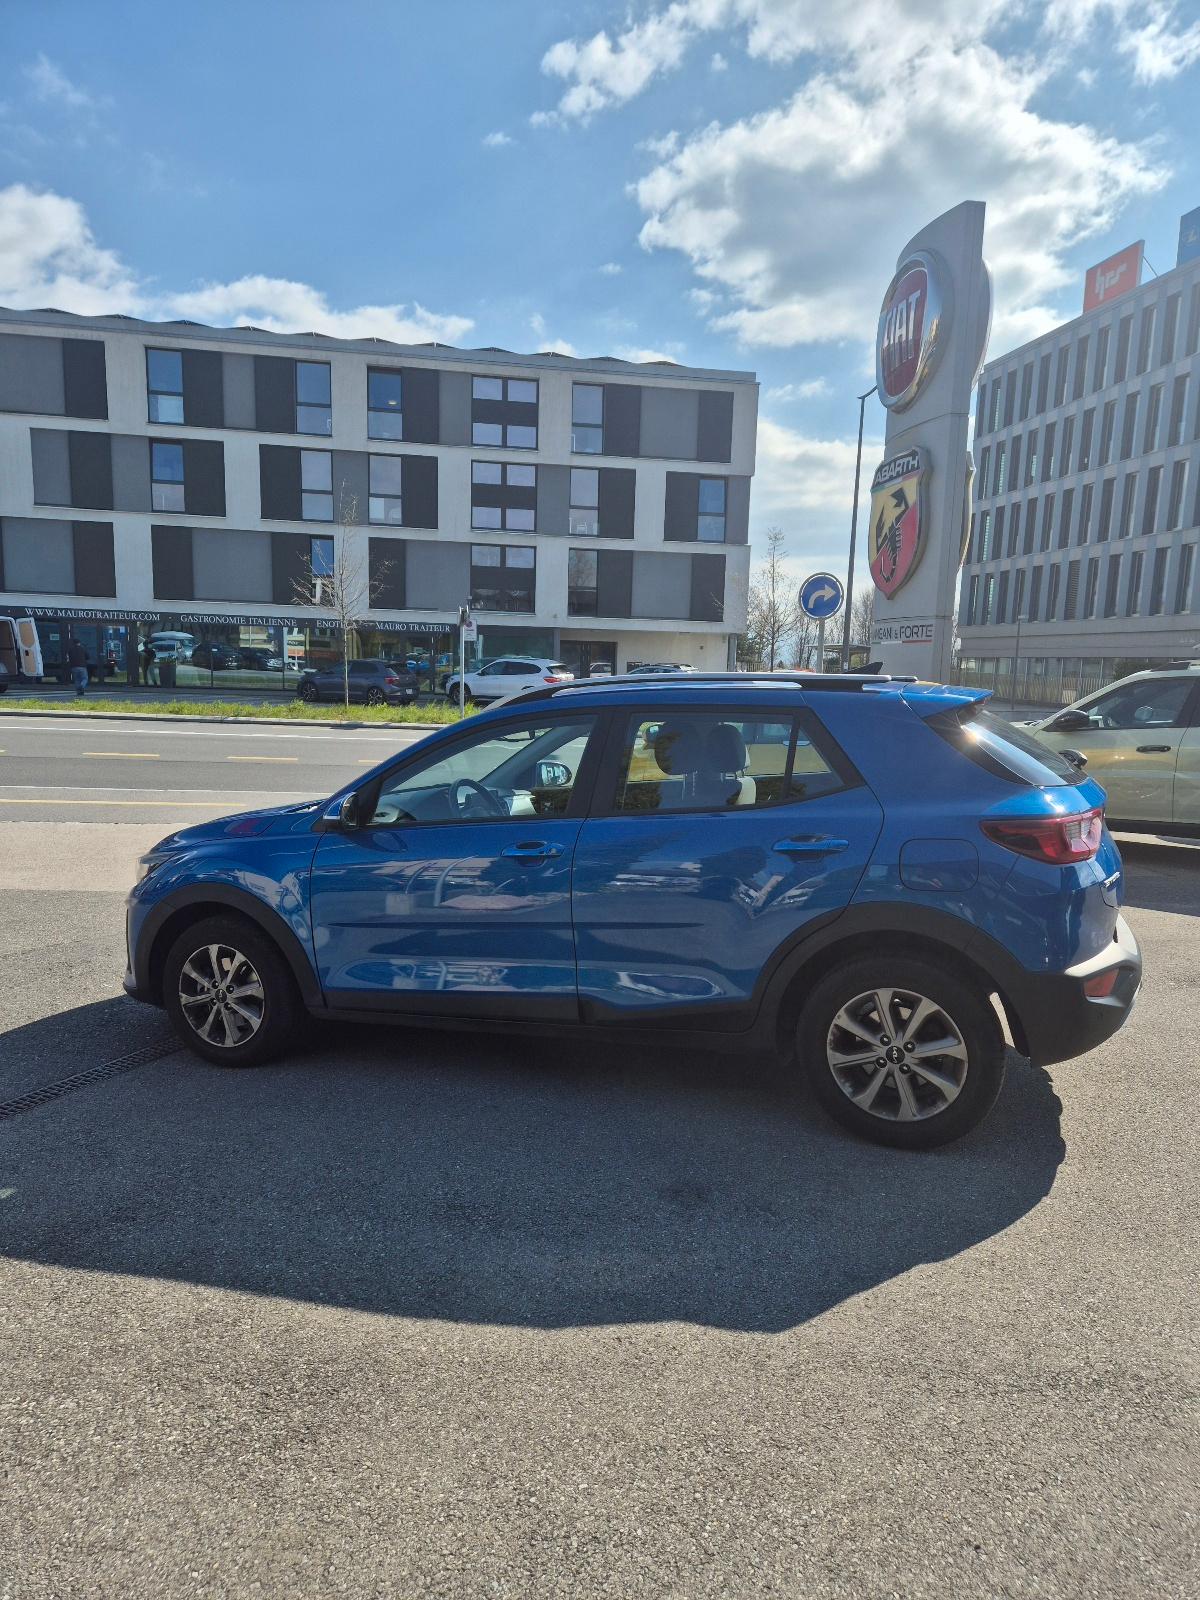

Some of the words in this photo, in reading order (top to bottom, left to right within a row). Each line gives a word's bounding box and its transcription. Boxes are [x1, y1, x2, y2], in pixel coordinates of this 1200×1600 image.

[882, 290, 921, 370] FIAT
[874, 455, 919, 485] ABARTH
[25, 607, 160, 621] WWW.MAUROTRAITEUR.COM
[180, 614, 247, 625] GASTRONOMIE
[249, 617, 297, 627] ITALIENNE
[375, 621, 407, 631] MAURO
[409, 623, 450, 632] TRAITEUR
[899, 624, 933, 638] FORTE
